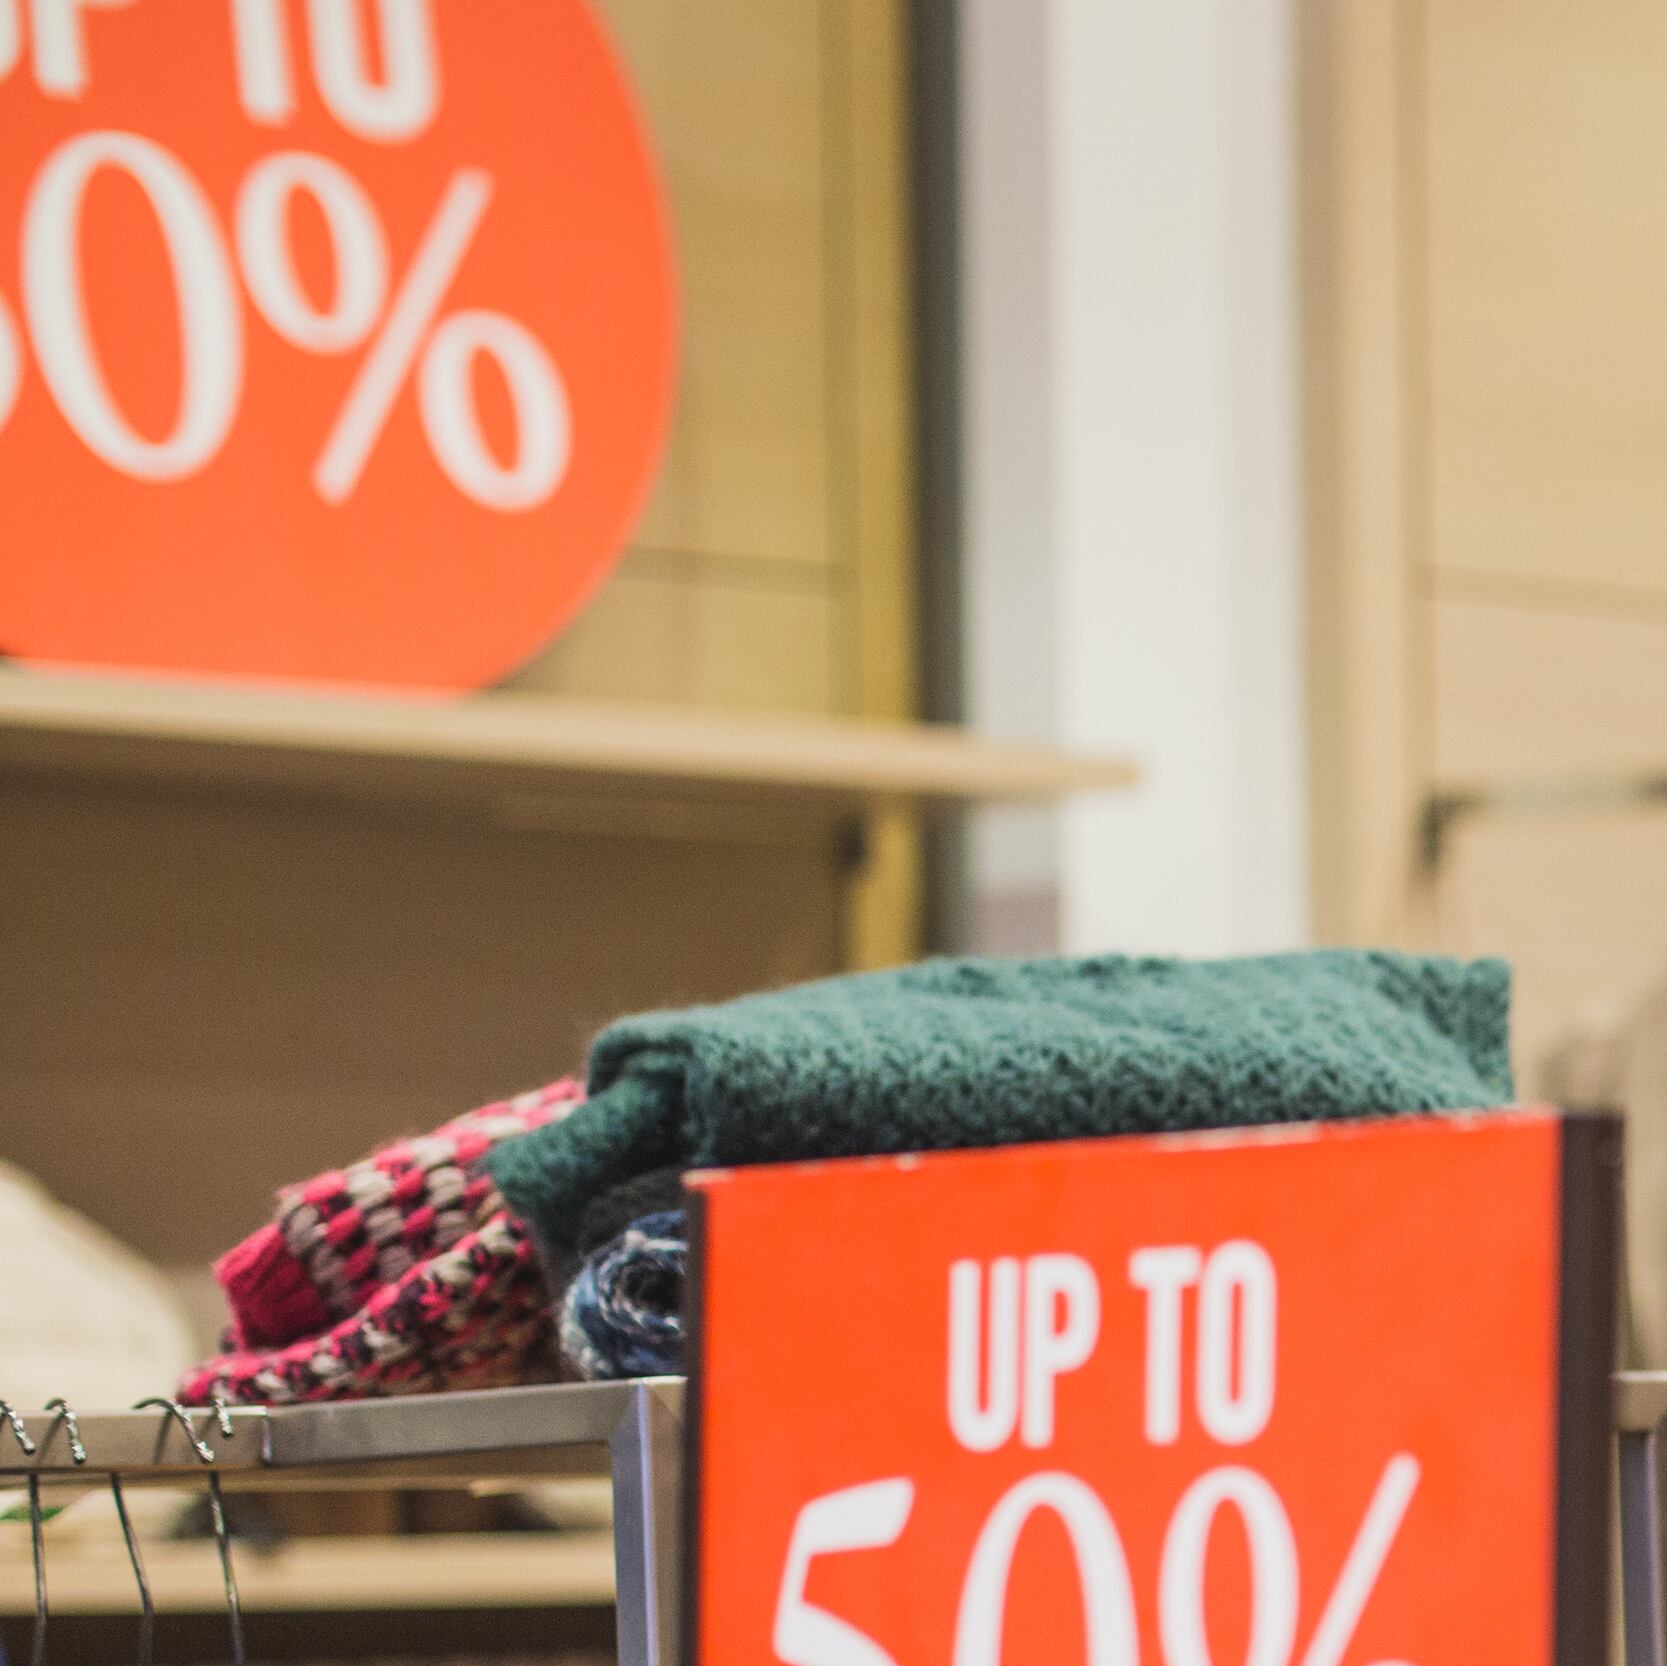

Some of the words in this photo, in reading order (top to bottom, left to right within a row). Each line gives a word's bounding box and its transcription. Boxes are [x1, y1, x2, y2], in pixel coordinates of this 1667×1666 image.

[0, 130, 571, 511] 0%
[946, 1252, 1101, 1452] UP
[1128, 1239, 1277, 1446] TO
